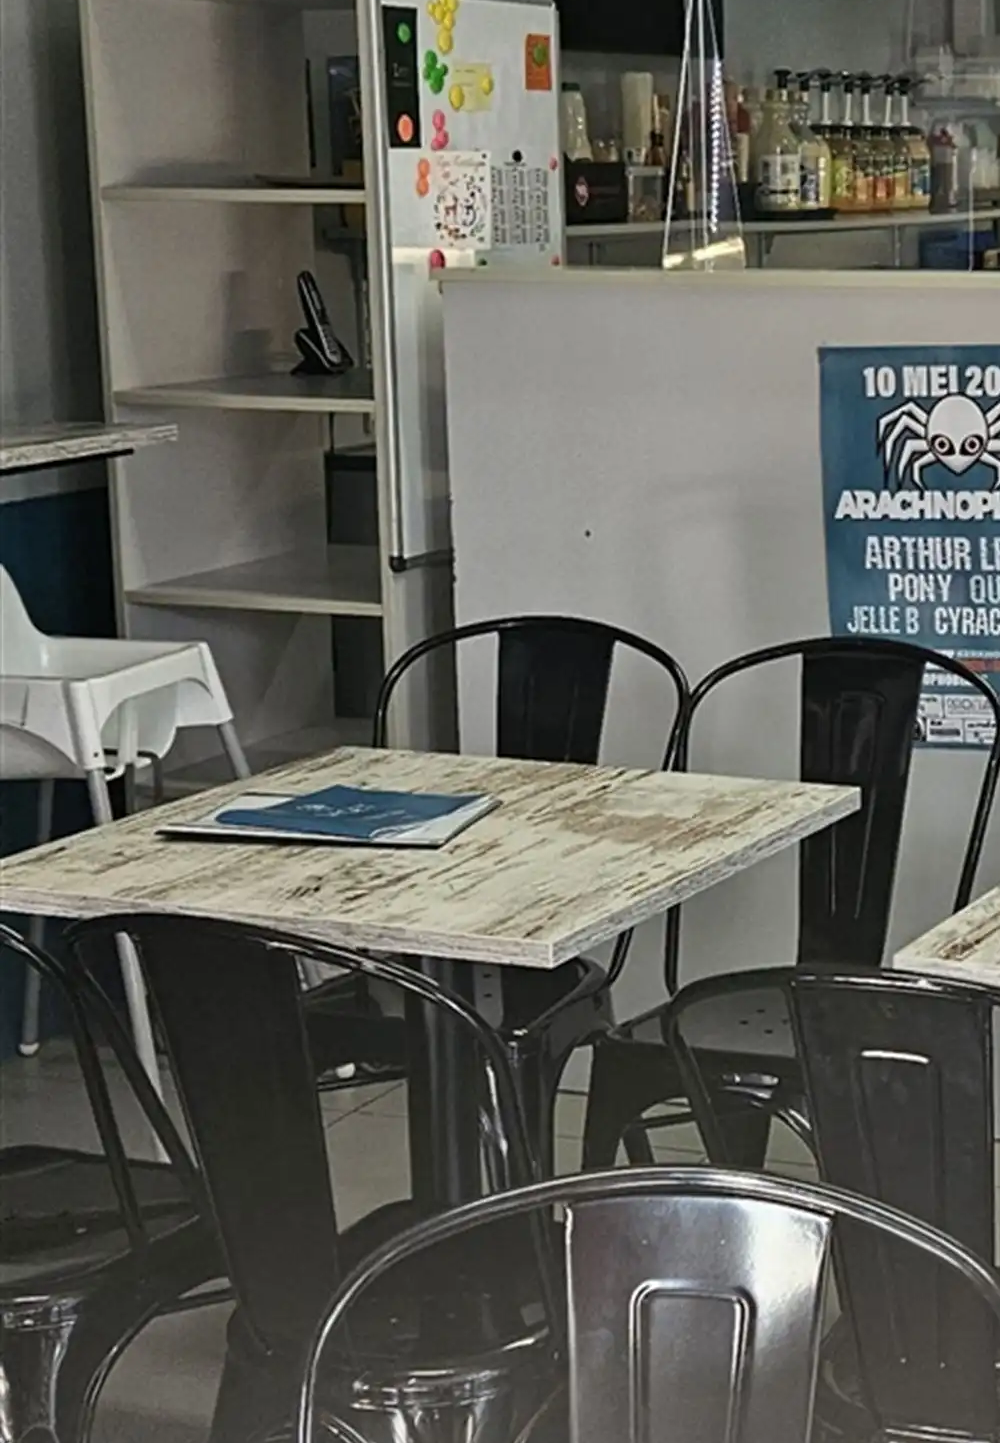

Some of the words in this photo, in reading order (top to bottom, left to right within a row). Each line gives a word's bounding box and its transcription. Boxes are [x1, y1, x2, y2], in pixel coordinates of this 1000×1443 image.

[863, 366, 897, 398] 10
[902, 365, 959, 398] MEI
[864, 535, 972, 571] ARTHUR
[888, 573, 952, 603] PONY
[846, 605, 901, 635] JELLE
[905, 607, 921, 635] B
